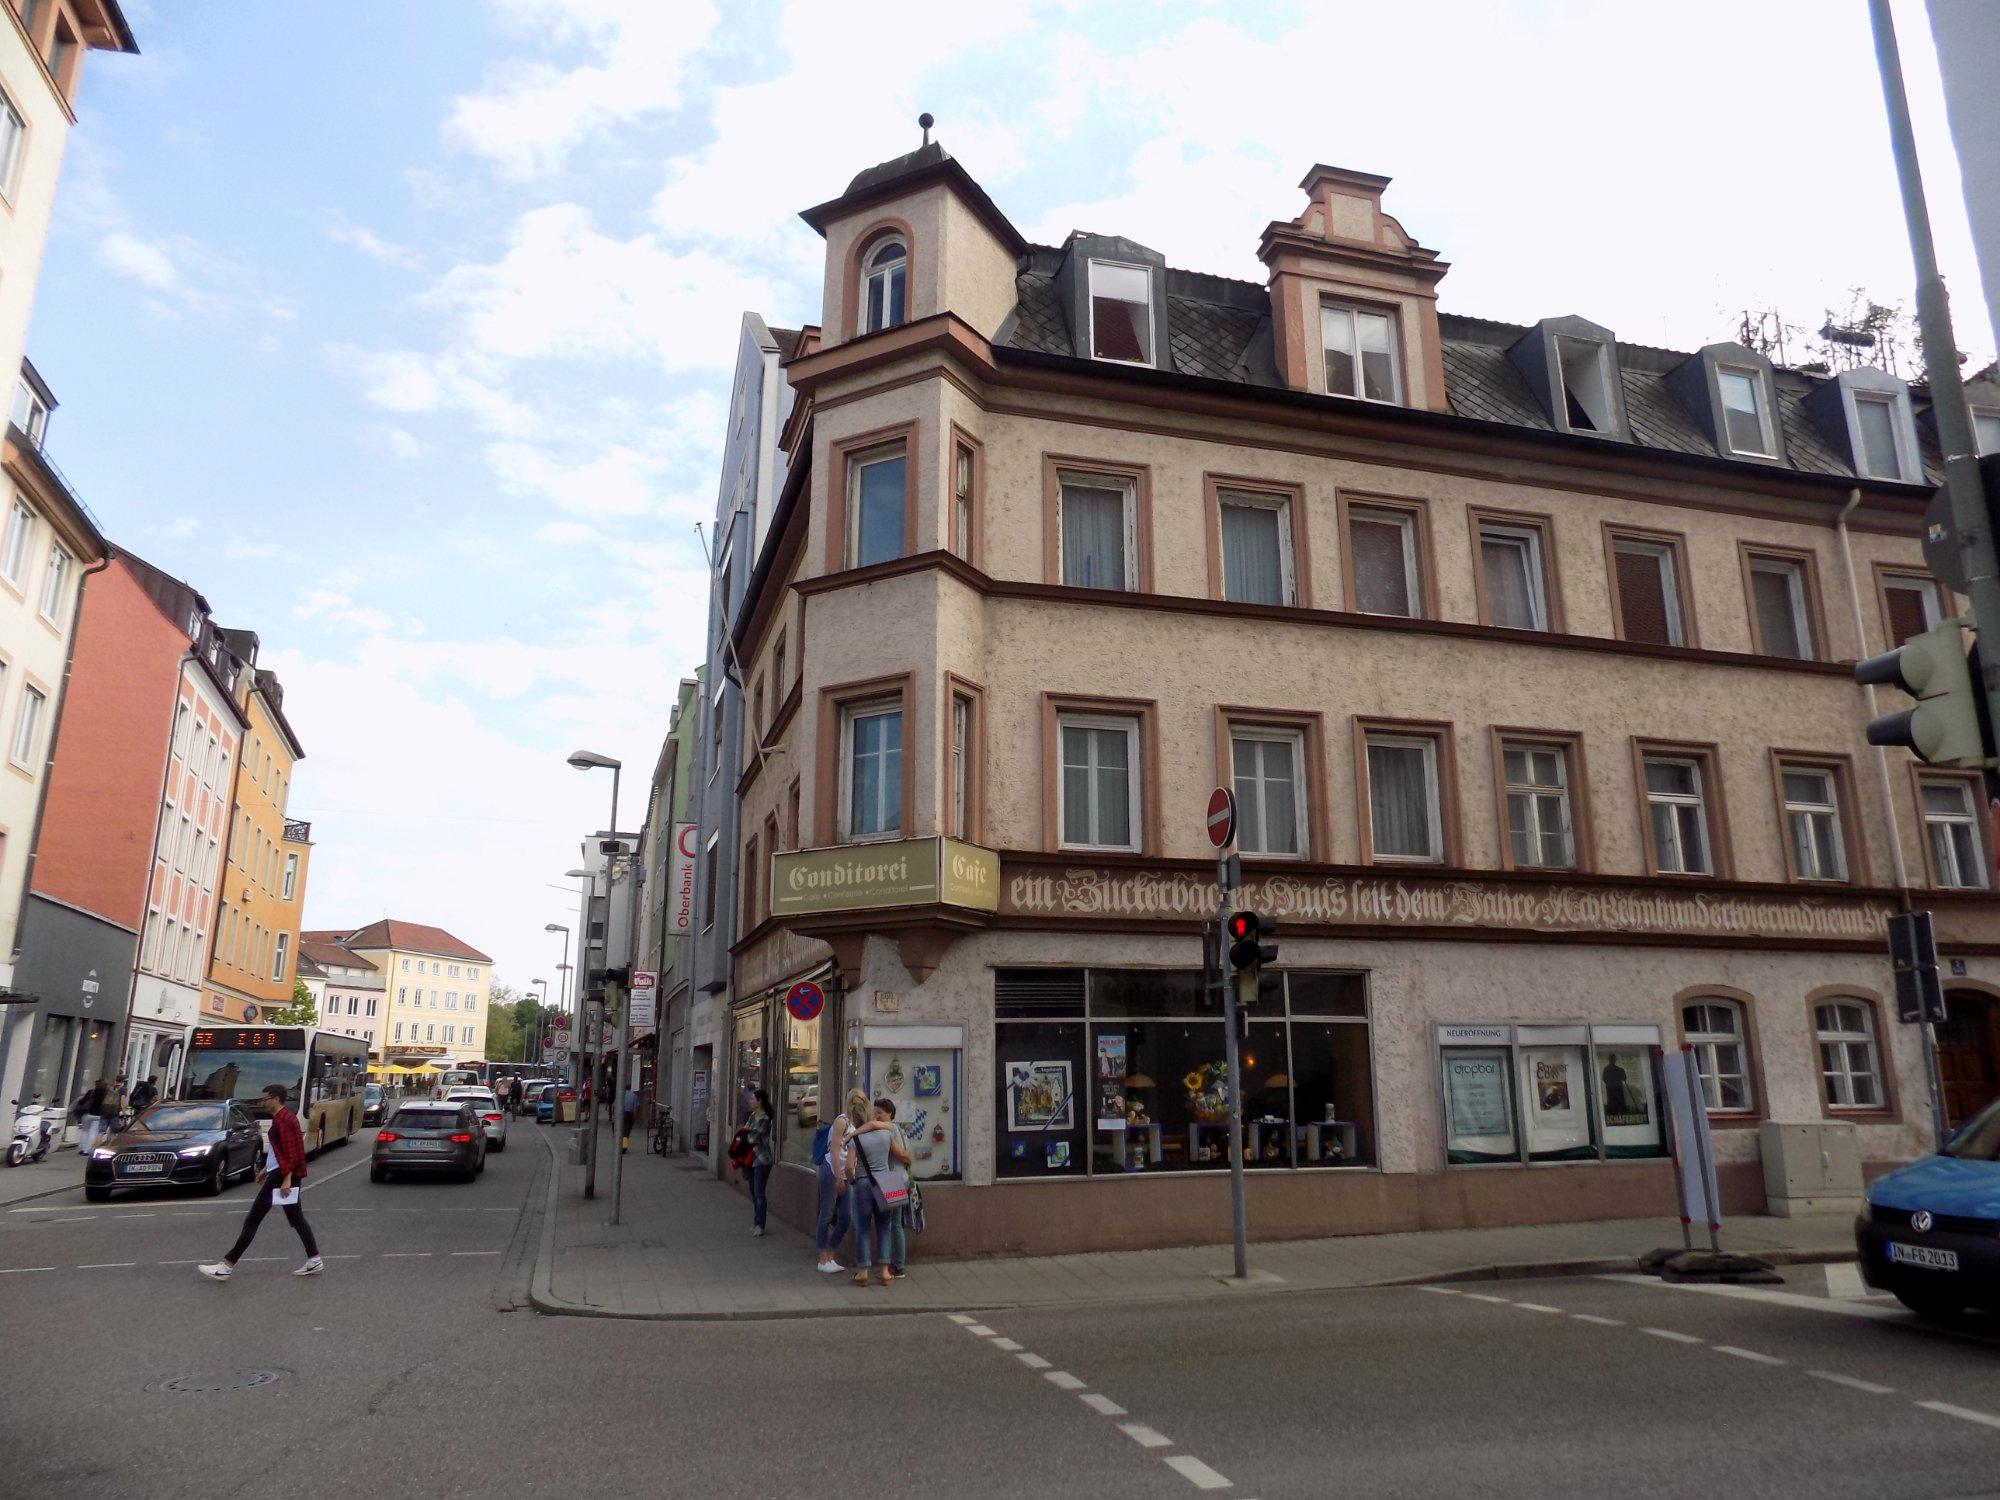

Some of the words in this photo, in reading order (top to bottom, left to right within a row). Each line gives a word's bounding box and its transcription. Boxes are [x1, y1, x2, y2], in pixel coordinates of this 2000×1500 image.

[789, 856, 907, 890] Conditorei
[678, 864, 692, 927] Oberbank
[1396, 880, 1450, 922] dem
[1444, 882, 1540, 927] Jahre
[1446, 1029, 1501, 1038] NEUERÖFFNUNG
[1454, 1062, 1496, 1079] dropbar
[1893, 1244, 1905, 1259] IN
[1911, 1248, 1926, 1262] FG
[1927, 1250, 1956, 1267] 2013
